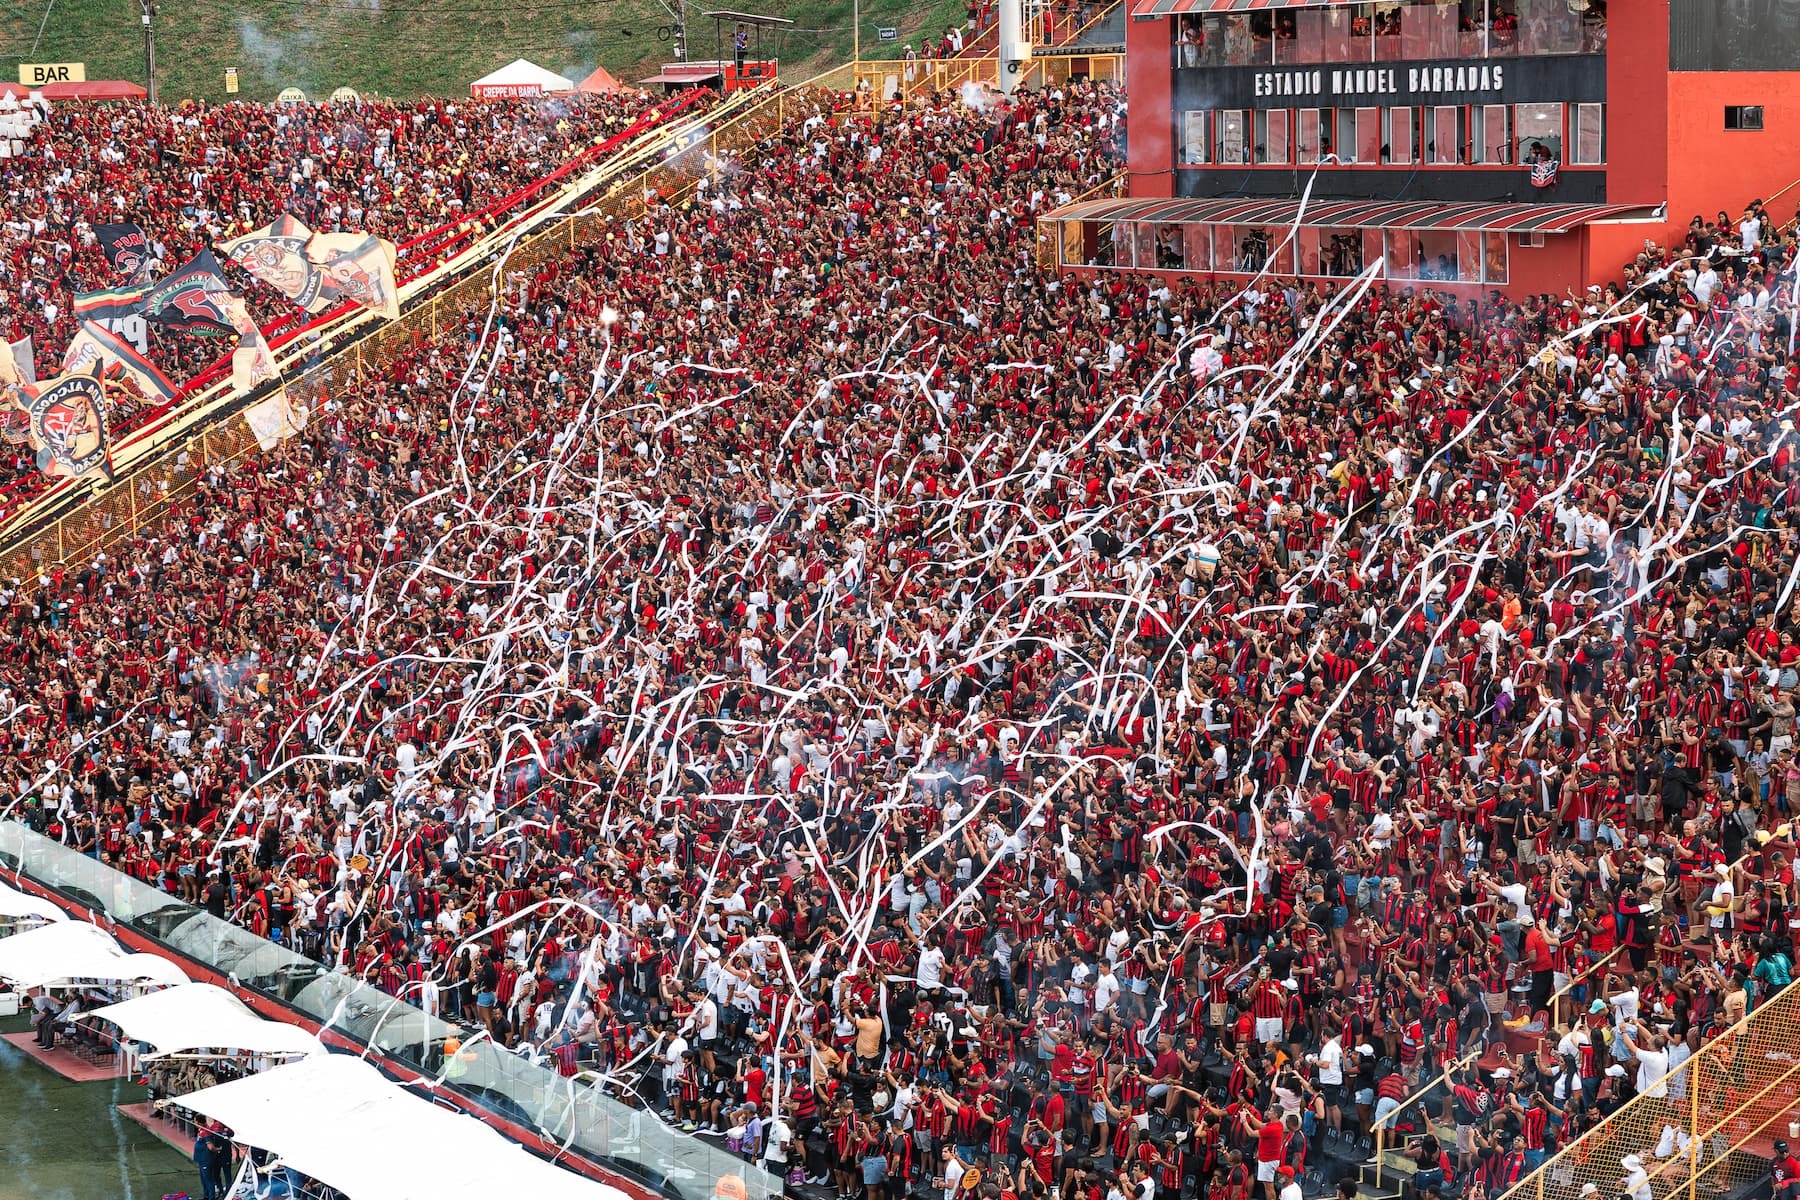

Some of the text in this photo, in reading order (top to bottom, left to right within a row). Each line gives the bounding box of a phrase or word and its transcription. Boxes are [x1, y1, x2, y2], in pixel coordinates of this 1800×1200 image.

[34, 66, 69, 82] BAR
[1255, 66, 1503, 96] ESTADIO MANOEL BARRADAS
[483, 87, 507, 98] CREPPE
[509, 87, 518, 97] DA
